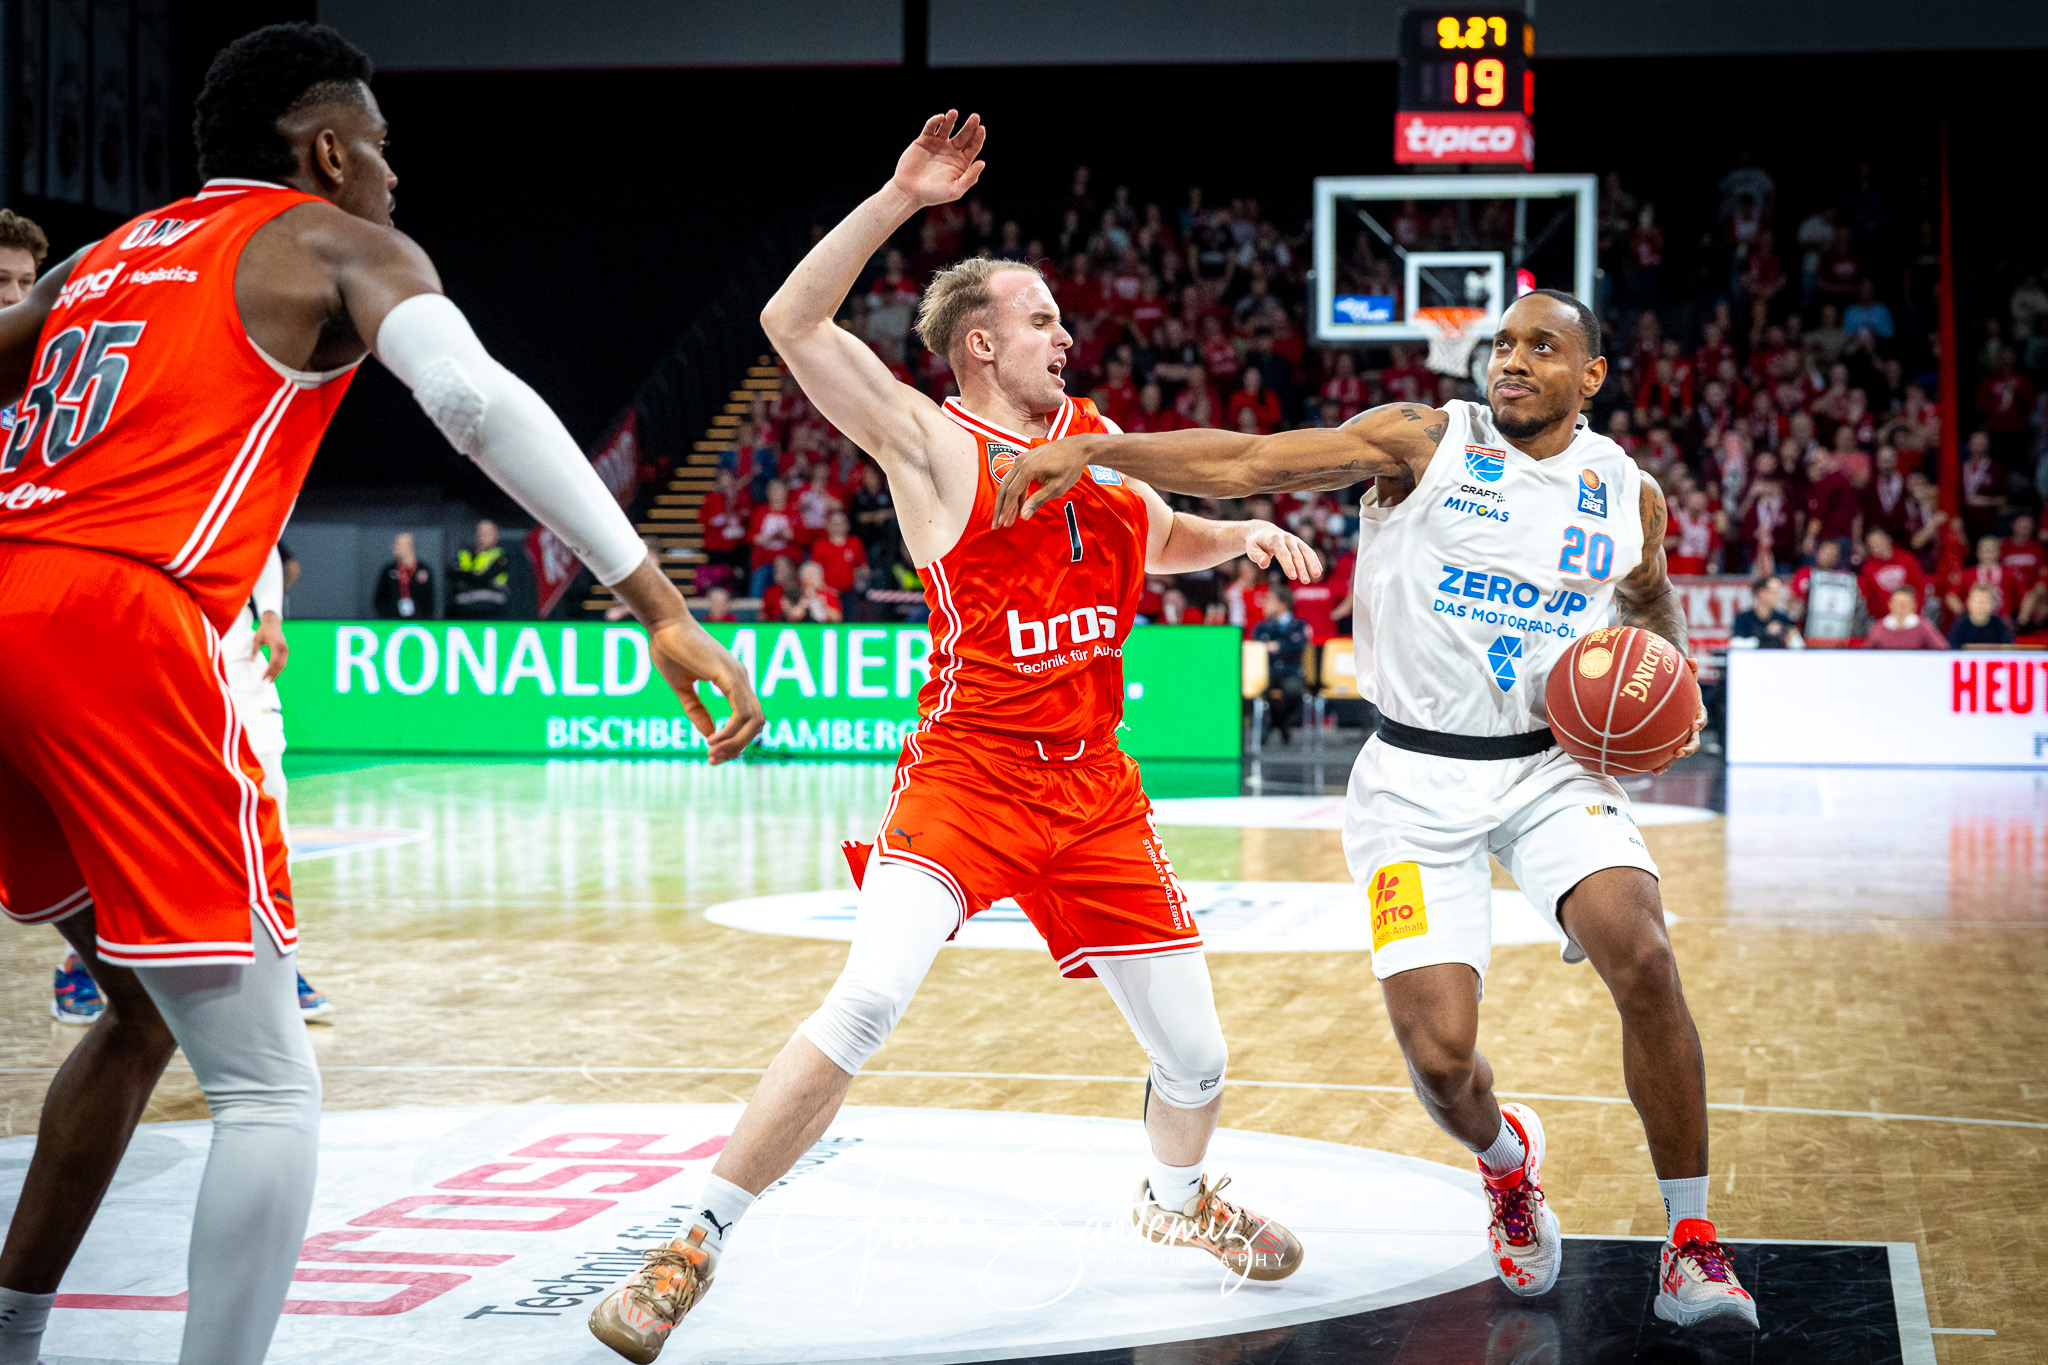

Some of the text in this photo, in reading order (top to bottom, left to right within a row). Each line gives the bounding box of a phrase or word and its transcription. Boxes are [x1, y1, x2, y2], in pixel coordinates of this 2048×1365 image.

[1454, 58, 1505, 107] 19
[1405, 117, 1516, 158] tipico
[129, 265, 199, 285] logistics
[0, 320, 147, 473] 35
[1444, 496, 1510, 523] MITGAS
[1461, 484, 1498, 501] CRAFT
[1581, 498, 1604, 515] BBL
[1064, 501, 1083, 562] 1
[1557, 525, 1615, 581] 20
[1434, 599, 1466, 618] DAS
[1438, 565, 1540, 609] ZERO
[334, 625, 652, 697] RONALD
[1013, 653, 1069, 674] Technik
[1070, 649, 1088, 662] für
[1142, 838, 1182, 931] STIRKAT & KOLLEGEN
[464, 1245, 654, 1320] Technik
